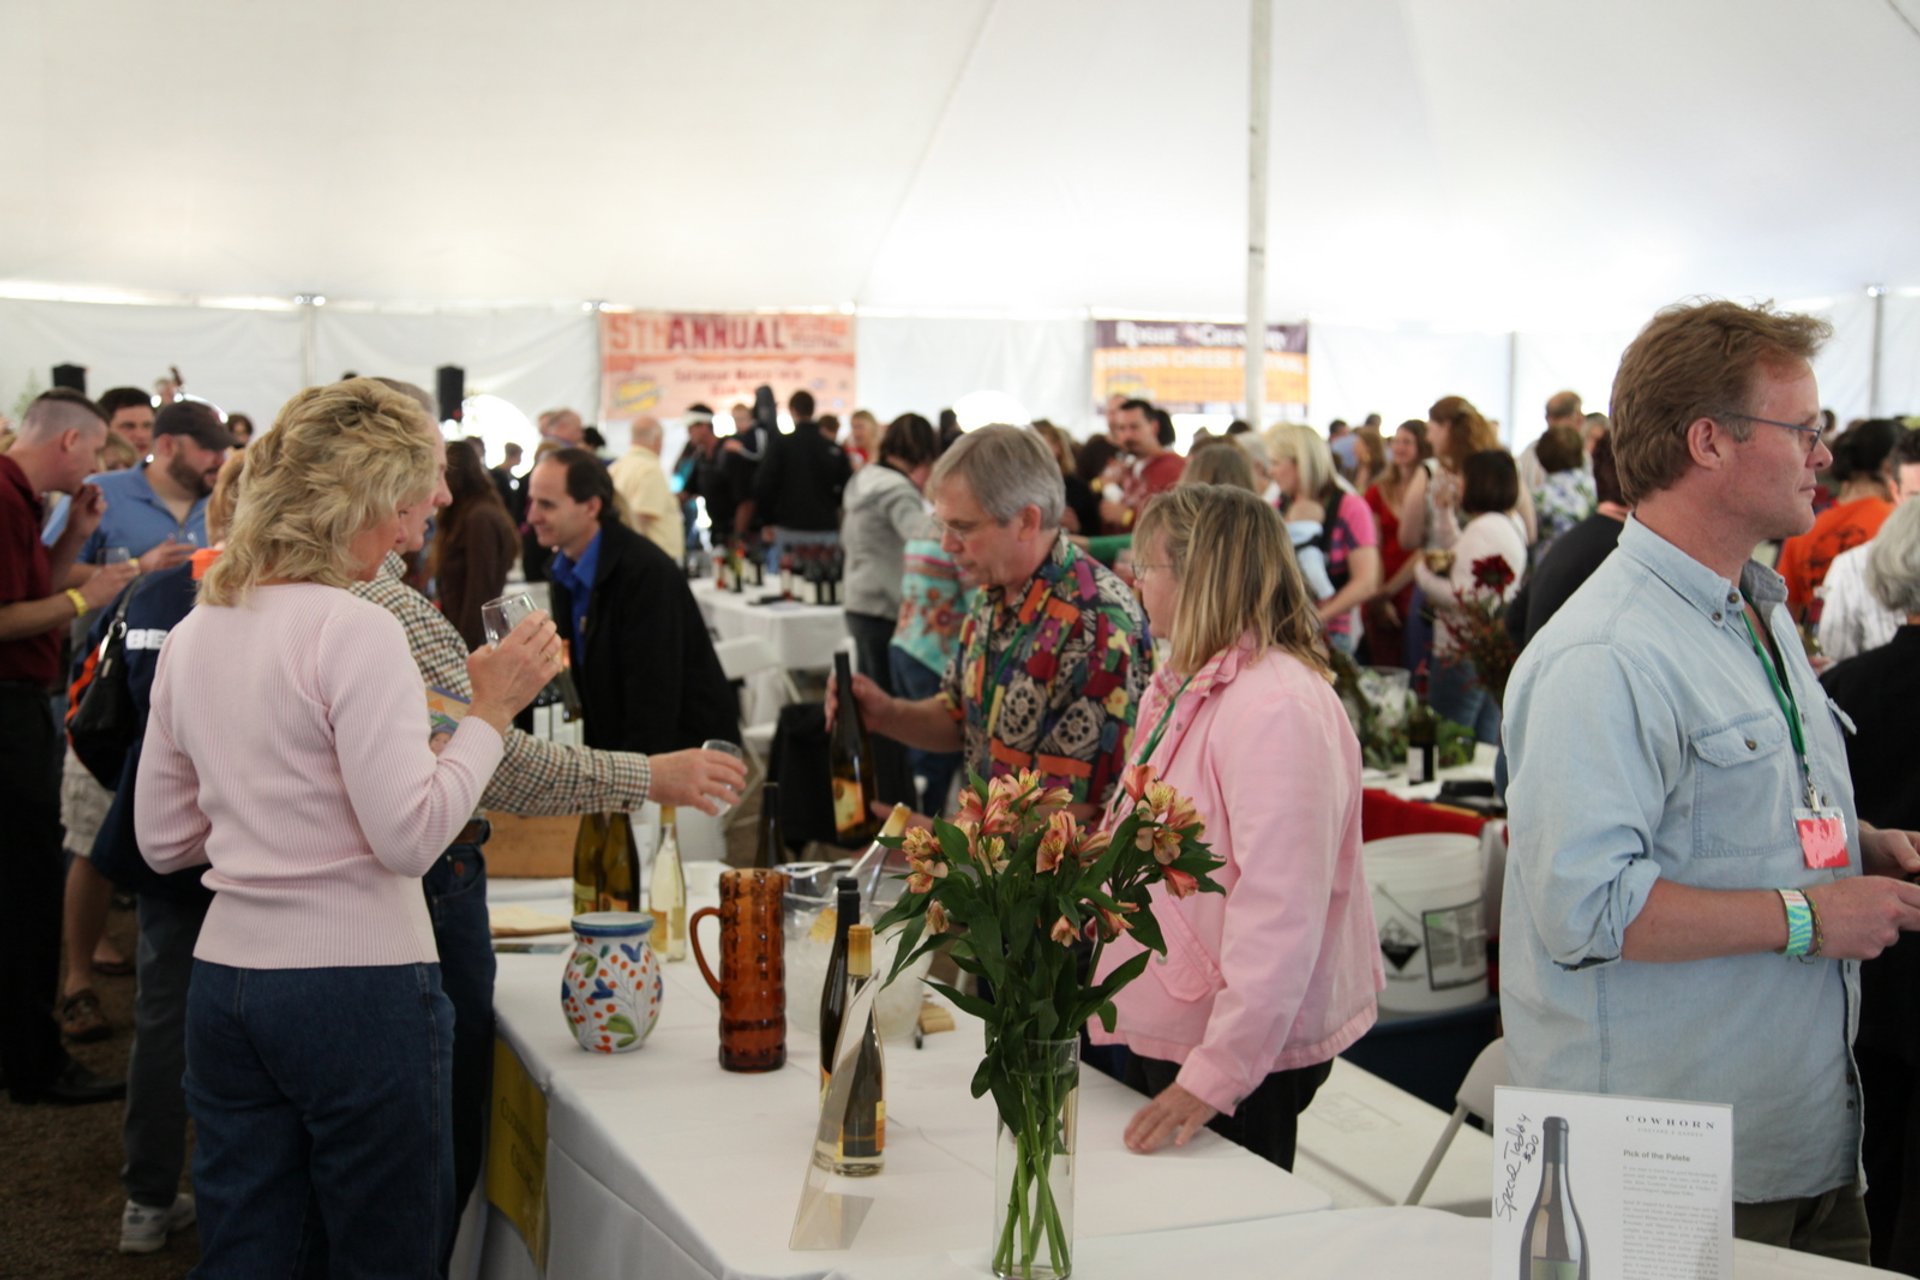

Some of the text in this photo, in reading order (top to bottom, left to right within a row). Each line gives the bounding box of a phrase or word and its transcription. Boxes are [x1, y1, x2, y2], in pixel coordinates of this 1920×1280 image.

[668, 316, 786, 350] ANNUAL
[1625, 1114, 1715, 1129] COWHORN
[1623, 1148, 1640, 1158] Pick
[1641, 1151, 1650, 1159] of
[1651, 1151, 1665, 1161] the
